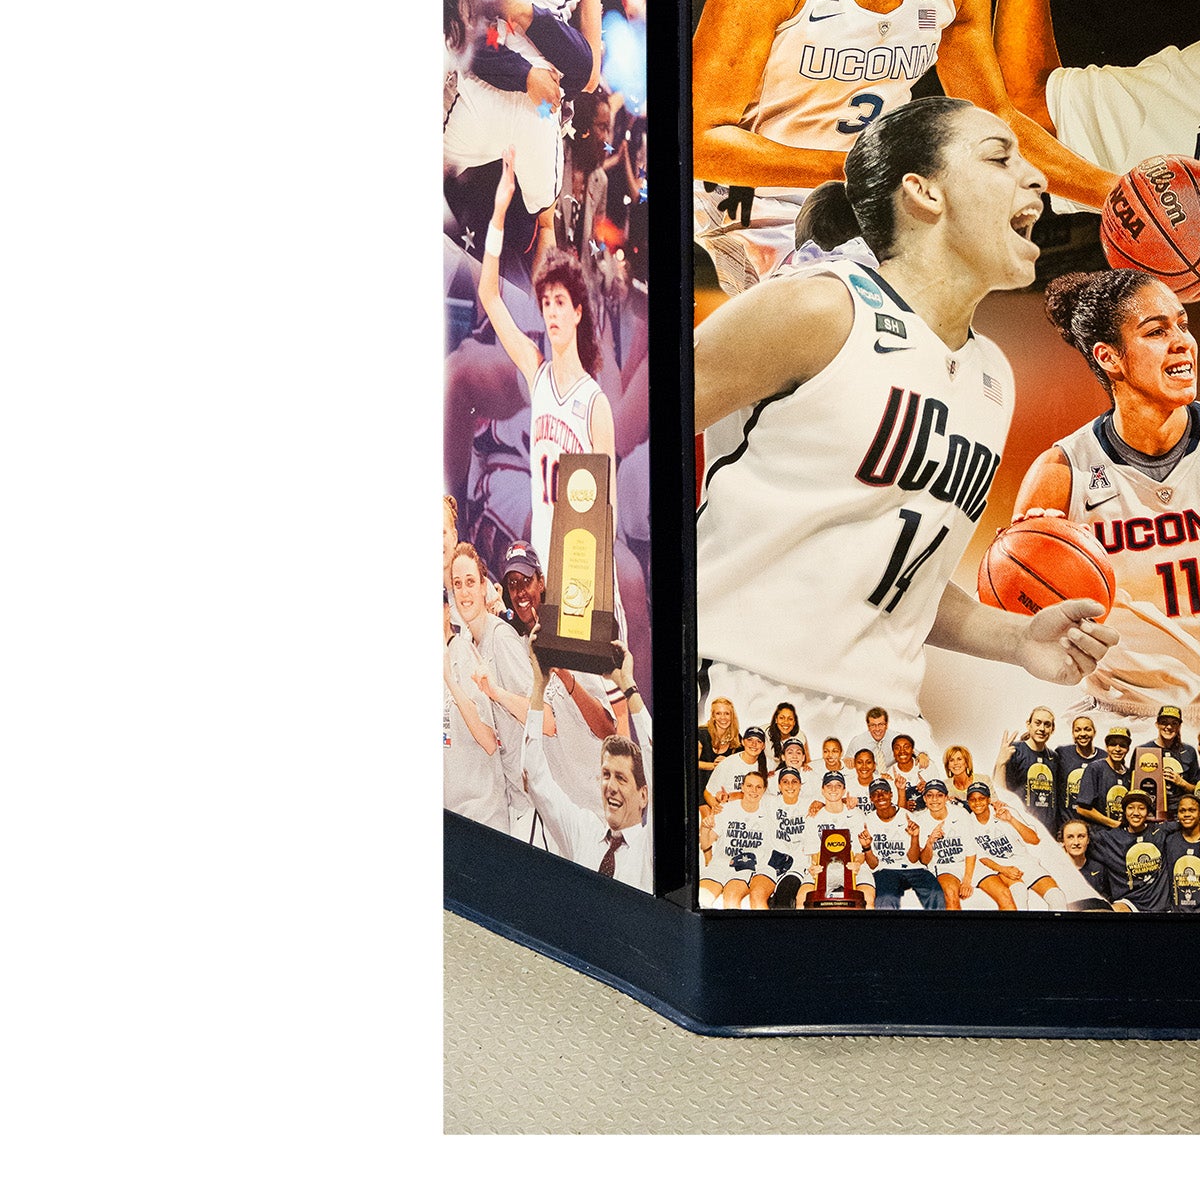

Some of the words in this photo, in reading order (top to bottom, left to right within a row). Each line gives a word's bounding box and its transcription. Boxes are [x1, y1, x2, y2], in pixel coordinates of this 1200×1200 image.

[798, 43, 936, 82] UCONN
[835, 93, 884, 136] 3
[1110, 183, 1146, 241] NCAA
[1138, 156, 1187, 229] Wilson
[884, 318, 900, 333] SH
[866, 508, 950, 614] 14
[727, 830, 763, 841] NATIONAL
[730, 839, 762, 848] CHAMP
